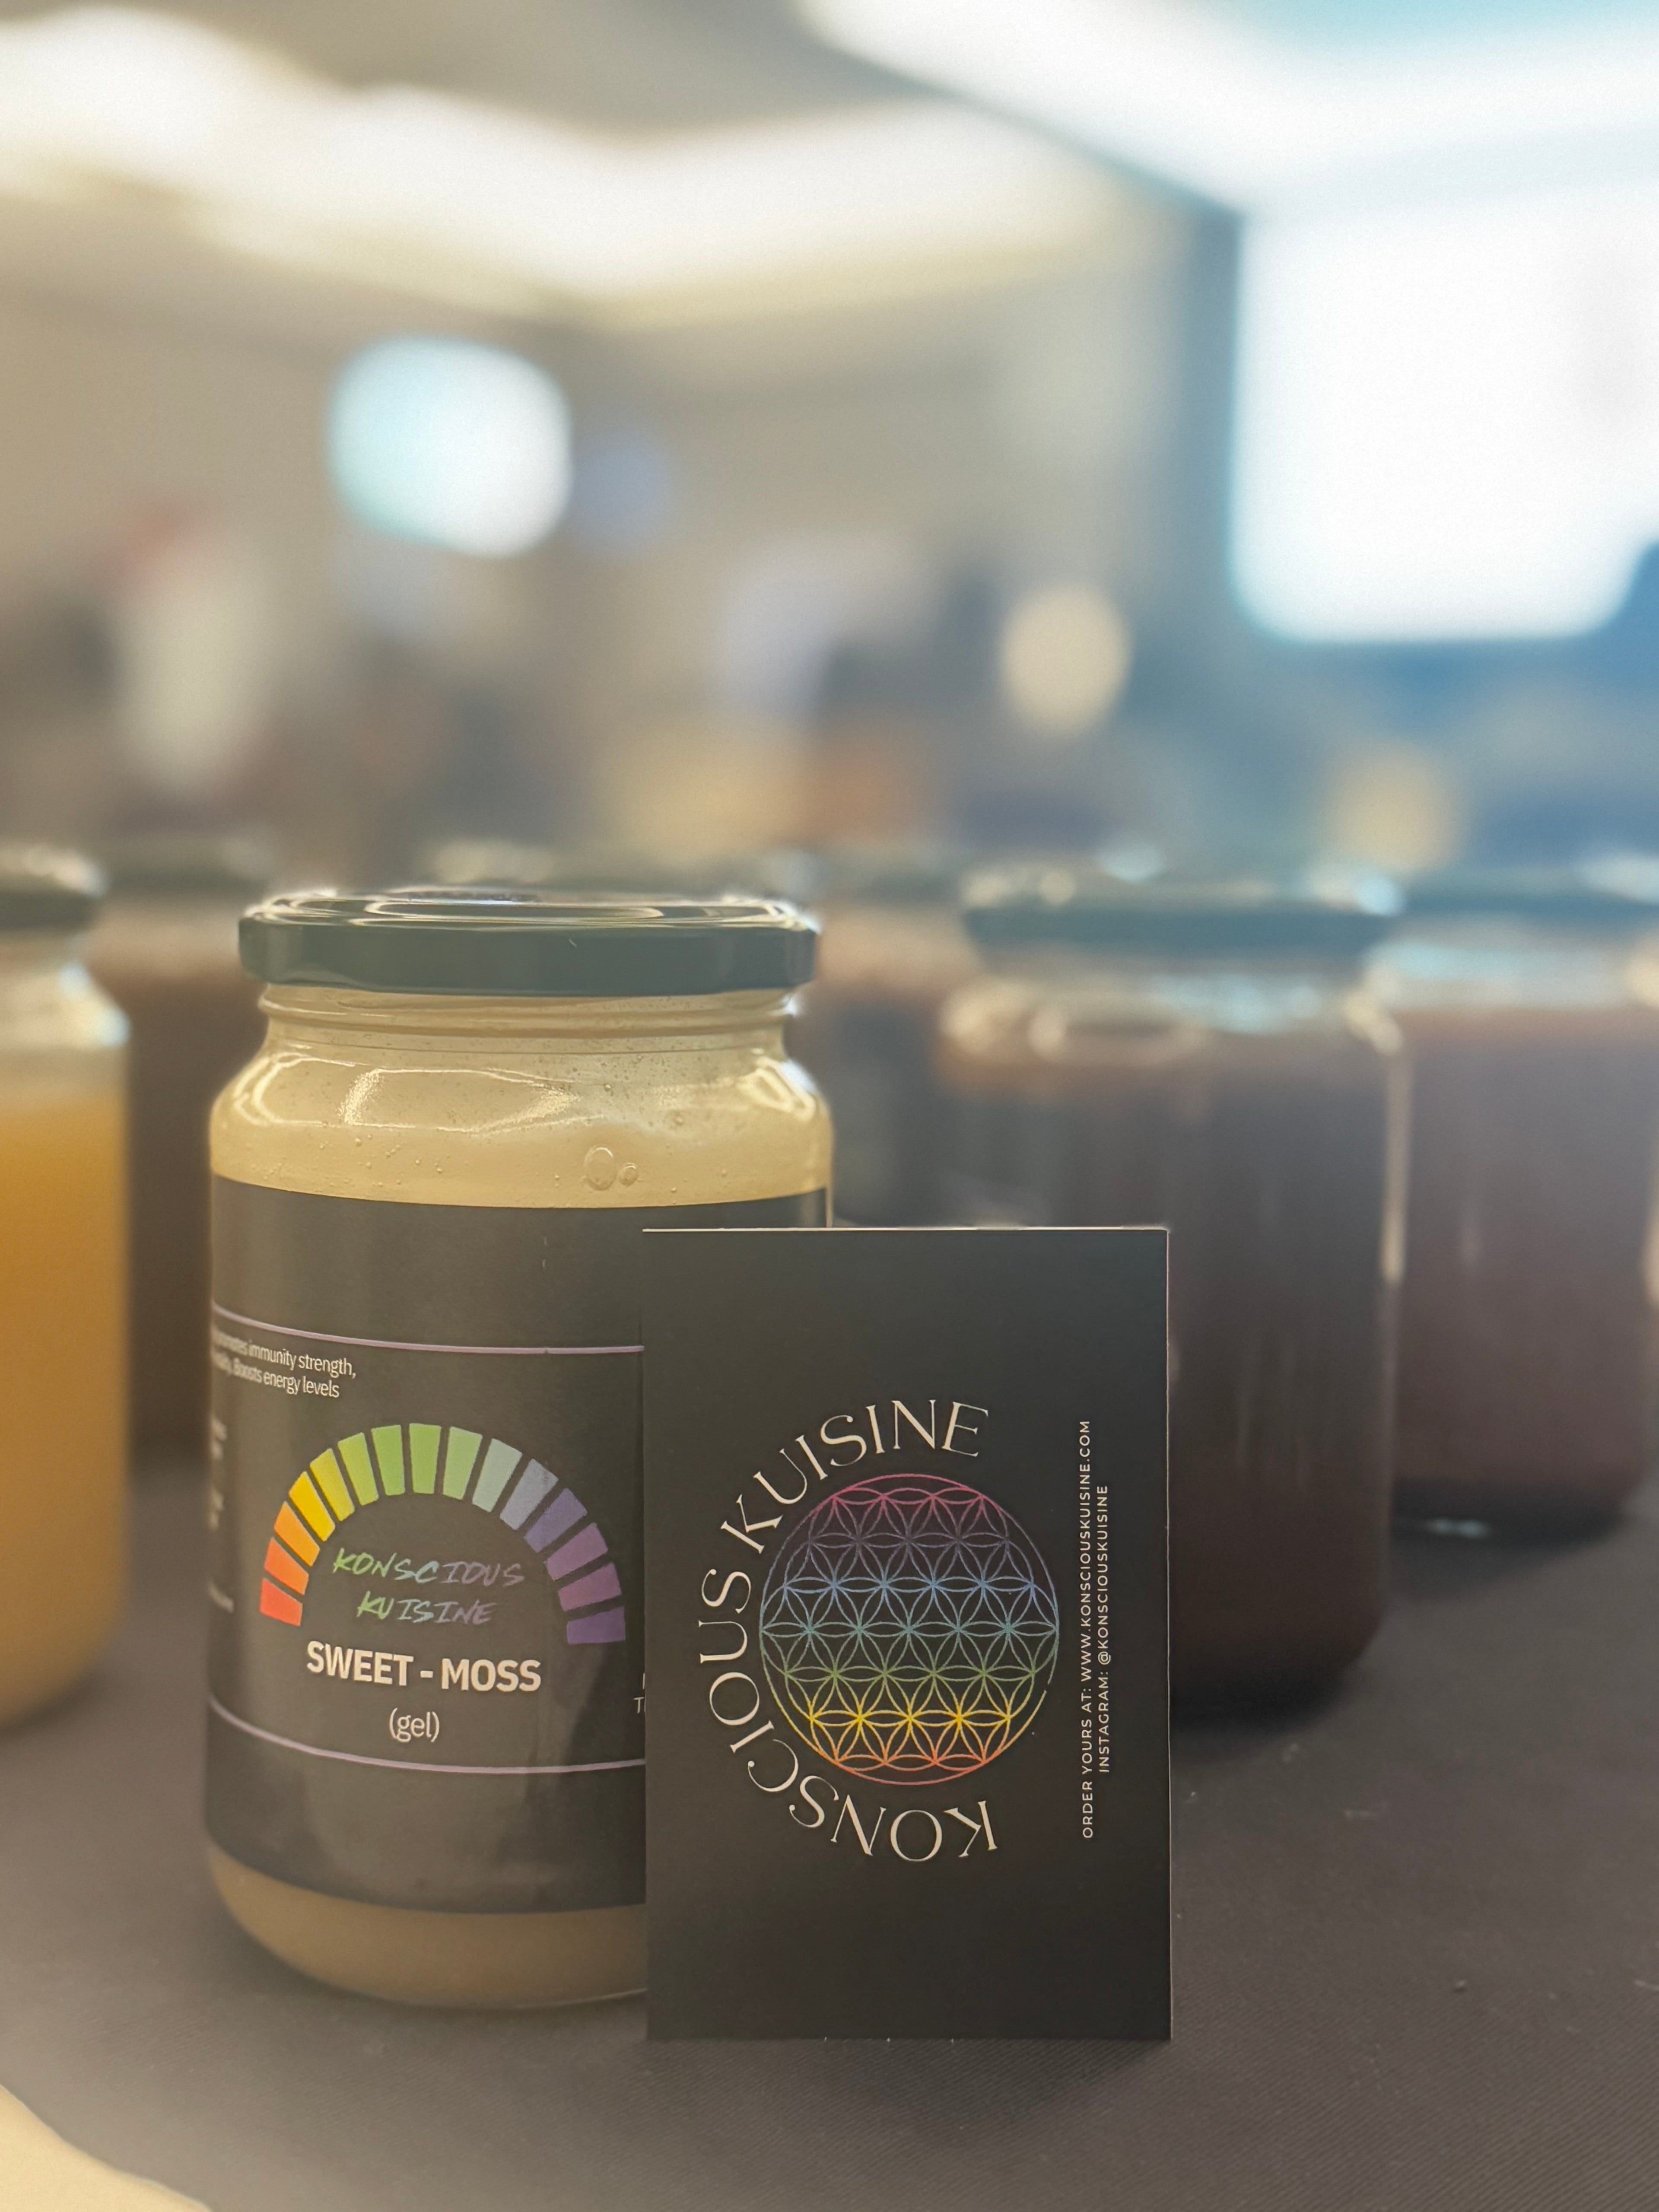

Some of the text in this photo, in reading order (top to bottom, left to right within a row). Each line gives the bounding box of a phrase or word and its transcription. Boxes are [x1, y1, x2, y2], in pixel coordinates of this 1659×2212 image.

[249, 1340, 296, 1371] immunity
[299, 1354, 356, 1379] strength,
[264, 1371, 301, 1395] energy
[303, 1376, 340, 1398] levels
[333, 1548, 525, 1587] KONSCIOUS
[356, 1590, 498, 1625] KUISINE
[698, 1399, 998, 1862] KONSCIOUS KUISINE
[1079, 1421, 1093, 1839] ORDER YOURS AT: WWW.KONSCIOUSKUISINE.COM
[1097, 1486, 1111, 1773] INSTAGRAM: @KONSCIOUSKUISINE
[307, 1640, 414, 1686] SWEET
[441, 1658, 541, 1692] MOSS
[389, 1707, 440, 1743] (gel)
